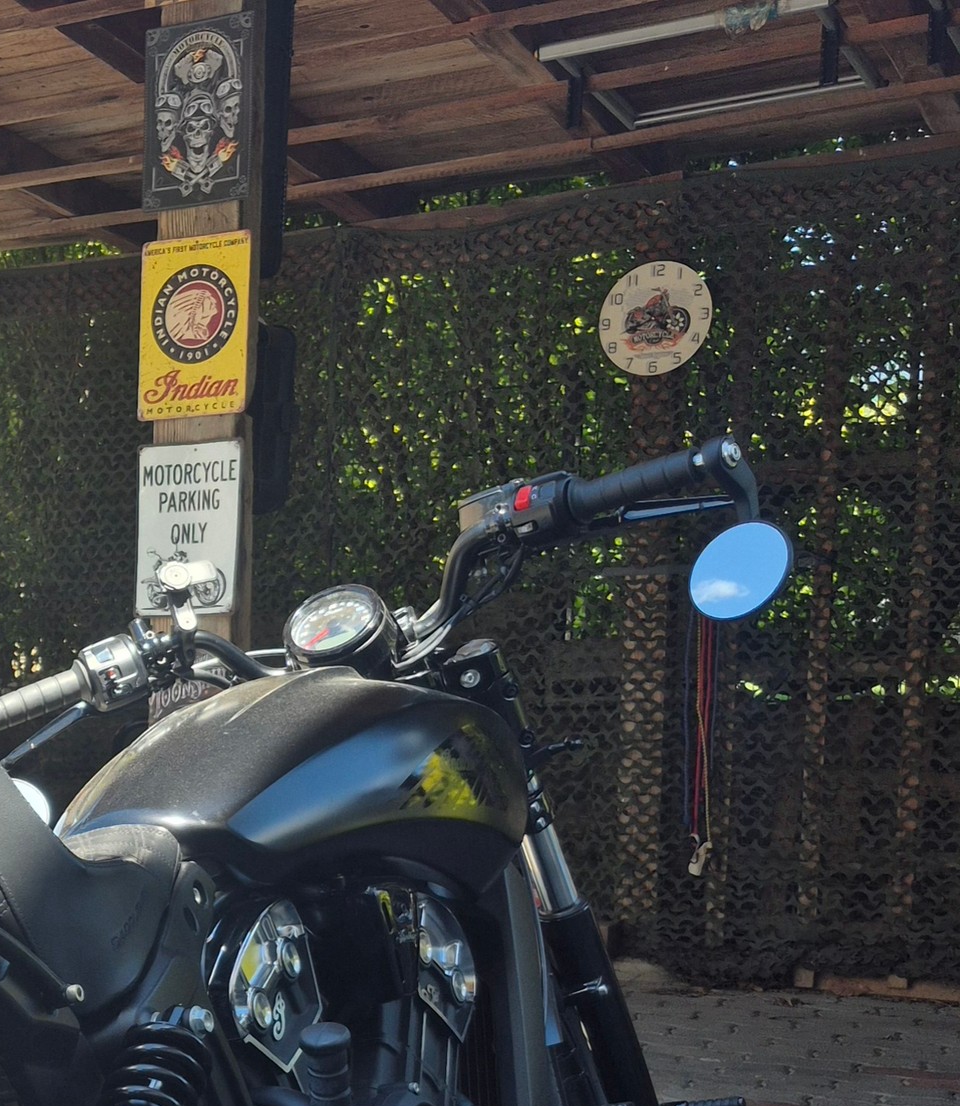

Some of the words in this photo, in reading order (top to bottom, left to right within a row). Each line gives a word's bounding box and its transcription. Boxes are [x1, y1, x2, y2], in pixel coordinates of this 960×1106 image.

[173, 33, 225, 55] MOTORCYCLE
[144, 247, 172, 257] AMERICA'S
[172, 245, 188, 255] FIRST
[188, 241, 223, 252] MOTORCYCLE
[223, 237, 249, 248] COMPANY
[652, 264, 666, 277] 12
[678, 267, 683, 280] 1
[628, 275, 639, 286] 11
[693, 284, 703, 297] 2
[610, 293, 624, 306] 10
[153, 284, 175, 350] INDIAN
[177, 267, 237, 340] MOTORCYCLE
[700, 307, 710, 318] 3
[601, 318, 611, 331] 9
[690, 332, 700, 344] 4
[178, 348, 209, 361] 1901
[608, 342, 617, 354] 8
[626, 357, 634, 370] 7
[673, 352, 682, 364] 5
[648, 361, 658, 374] 6
[143, 369, 239, 405] Indian
[146, 401, 235, 415] MOTORCYCLE
[142, 459, 238, 487] MOTORCYCLE
[158, 488, 221, 514] PARKING
[170, 522, 208, 545] ONLY
